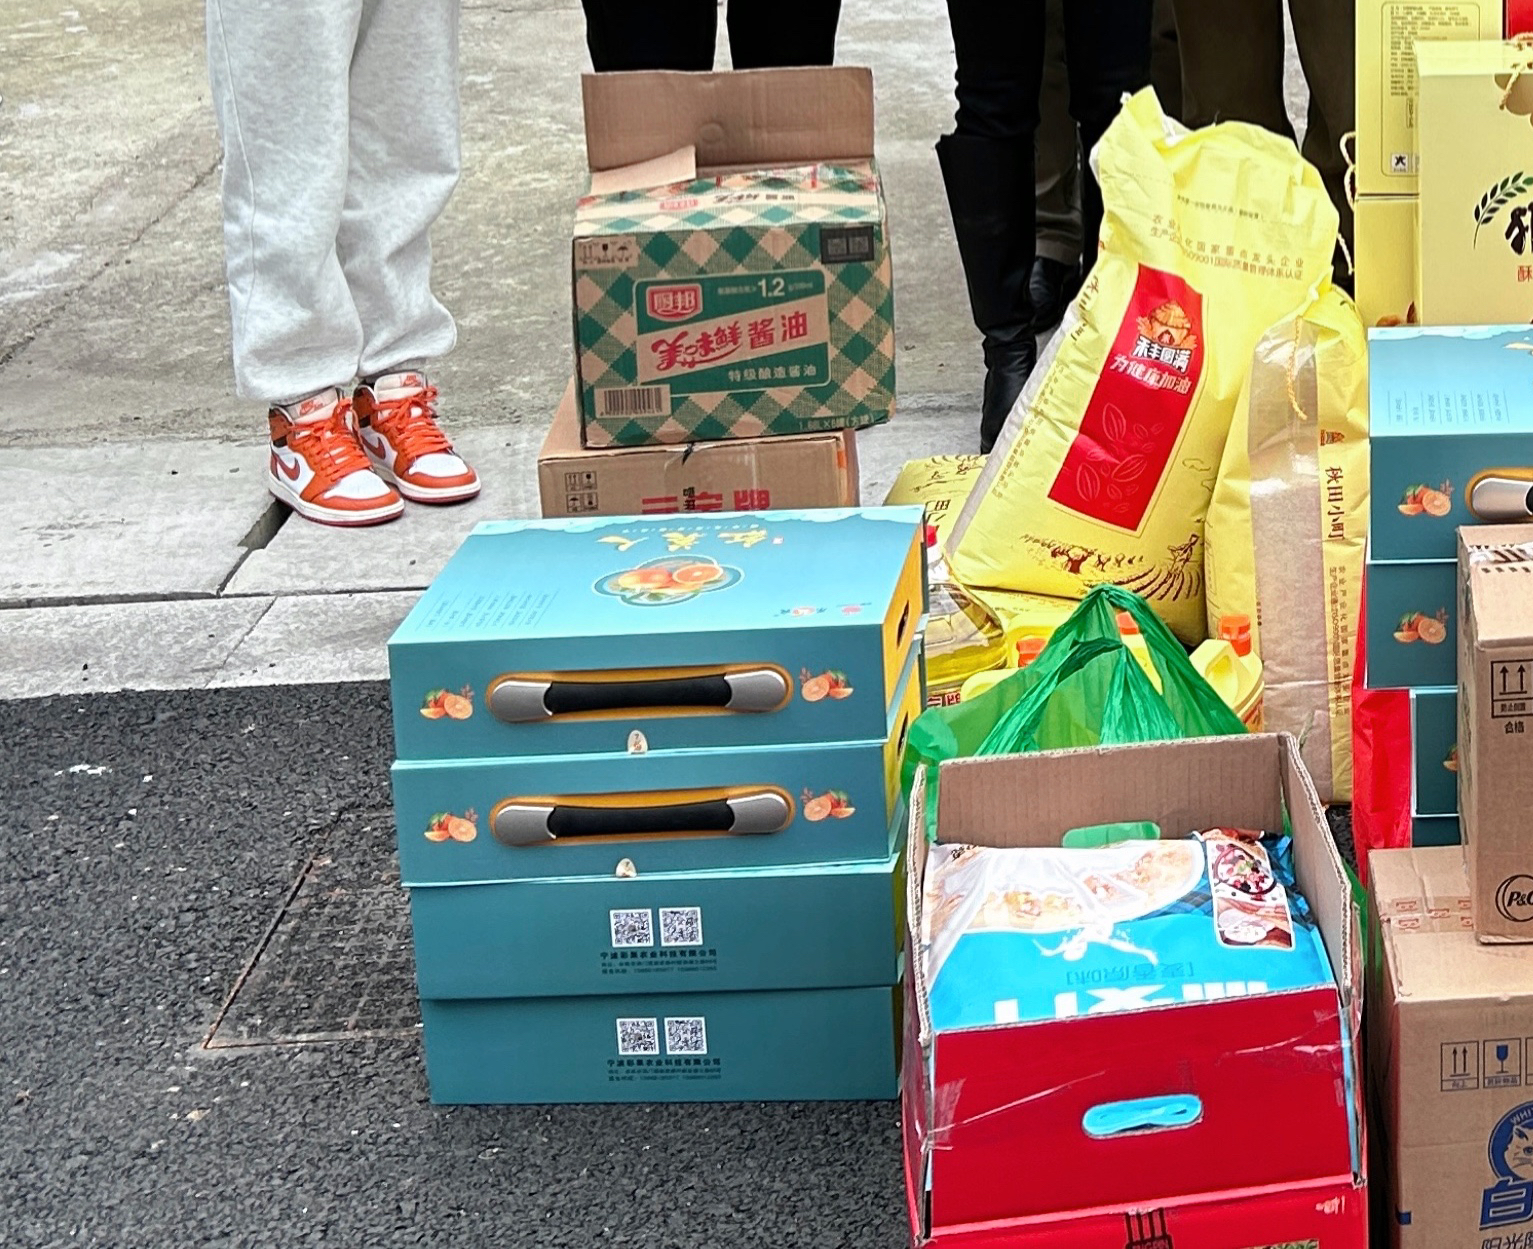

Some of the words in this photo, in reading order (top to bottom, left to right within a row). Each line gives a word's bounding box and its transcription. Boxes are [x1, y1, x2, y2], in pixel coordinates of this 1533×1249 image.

[757, 277, 785, 298] 1.2
[651, 311, 808, 371] 美味鲜酱油
[727, 364, 817, 382] 特级酿造酱油
[1110, 355, 1192, 394] 为健康加油
[1324, 466, 1345, 540] 秋田小町
[1504, 721, 1525, 734] 合格
